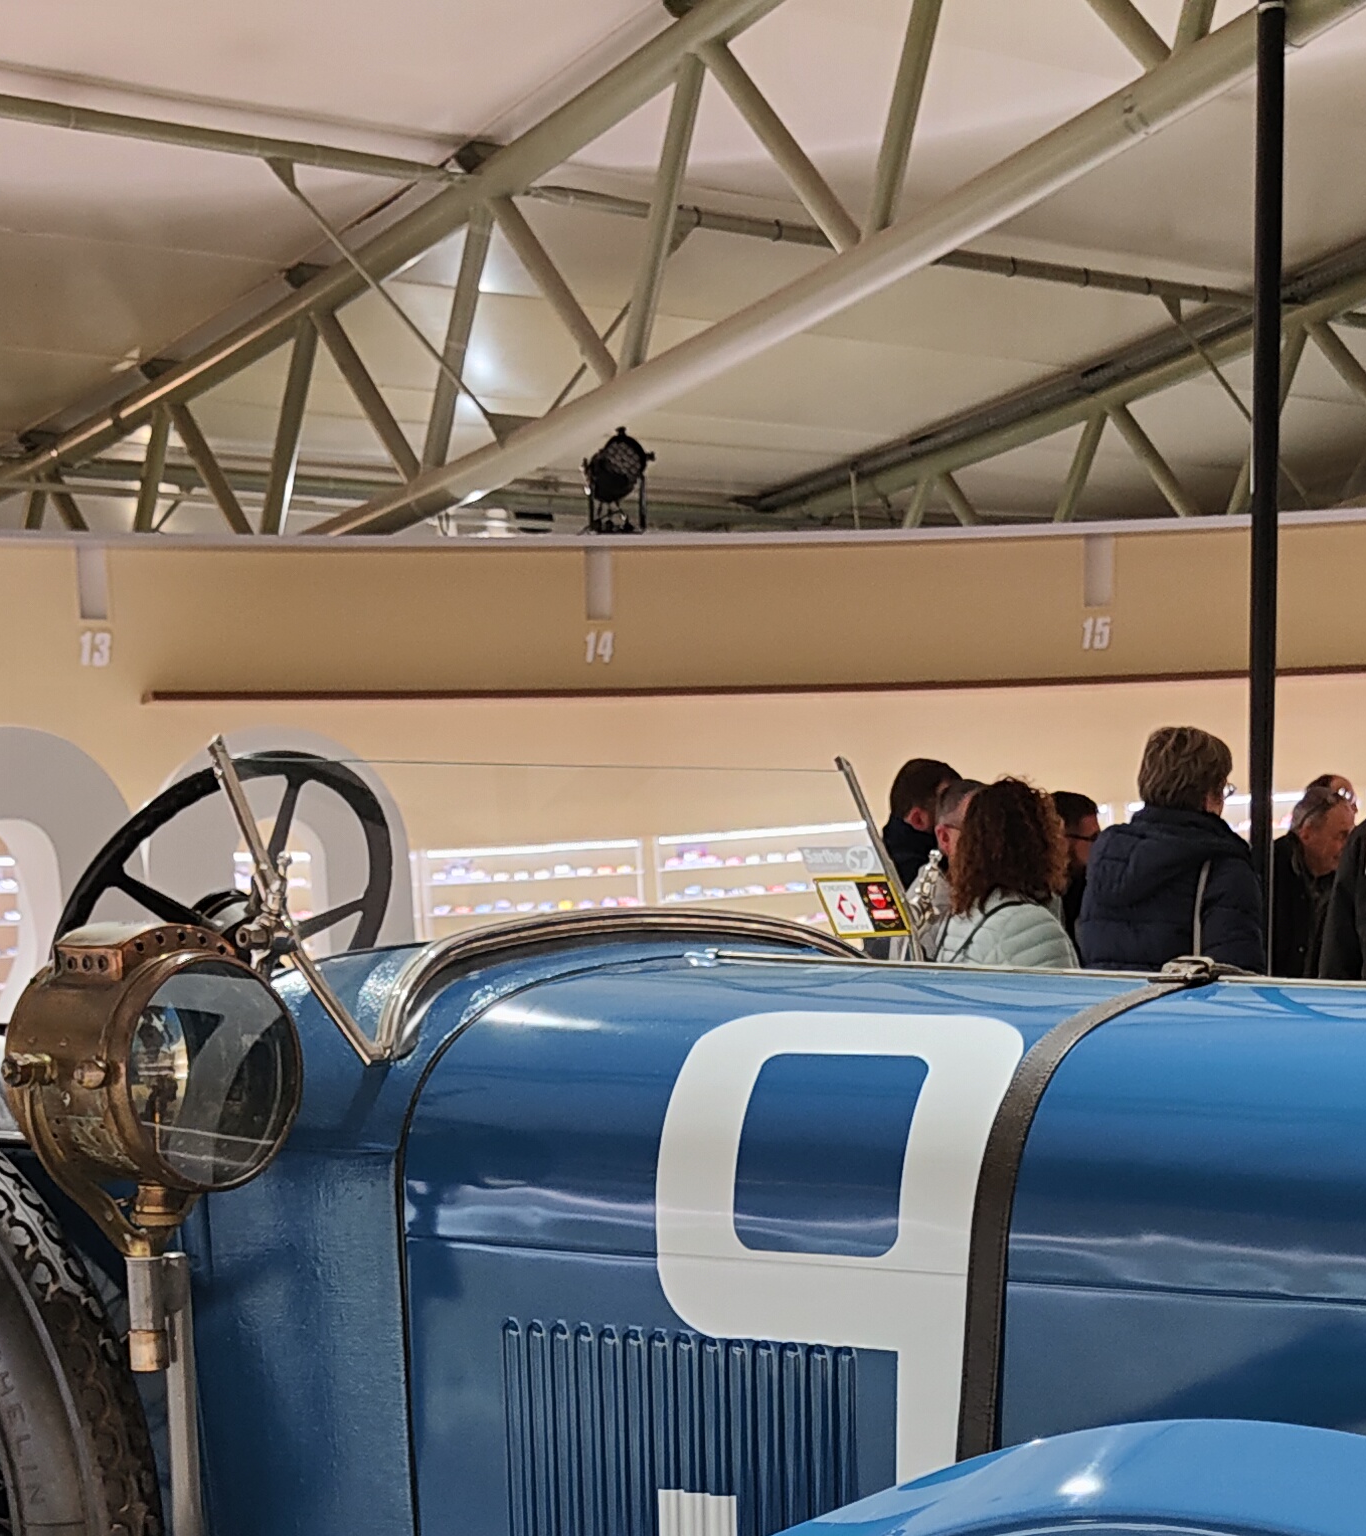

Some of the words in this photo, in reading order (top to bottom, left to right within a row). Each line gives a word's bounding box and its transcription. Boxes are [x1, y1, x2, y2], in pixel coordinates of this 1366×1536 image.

[79, 630, 113, 668] 13
[585, 631, 615, 665] 14
[1081, 615, 1113, 651] 15
[802, 849, 844, 864] Sarthe
